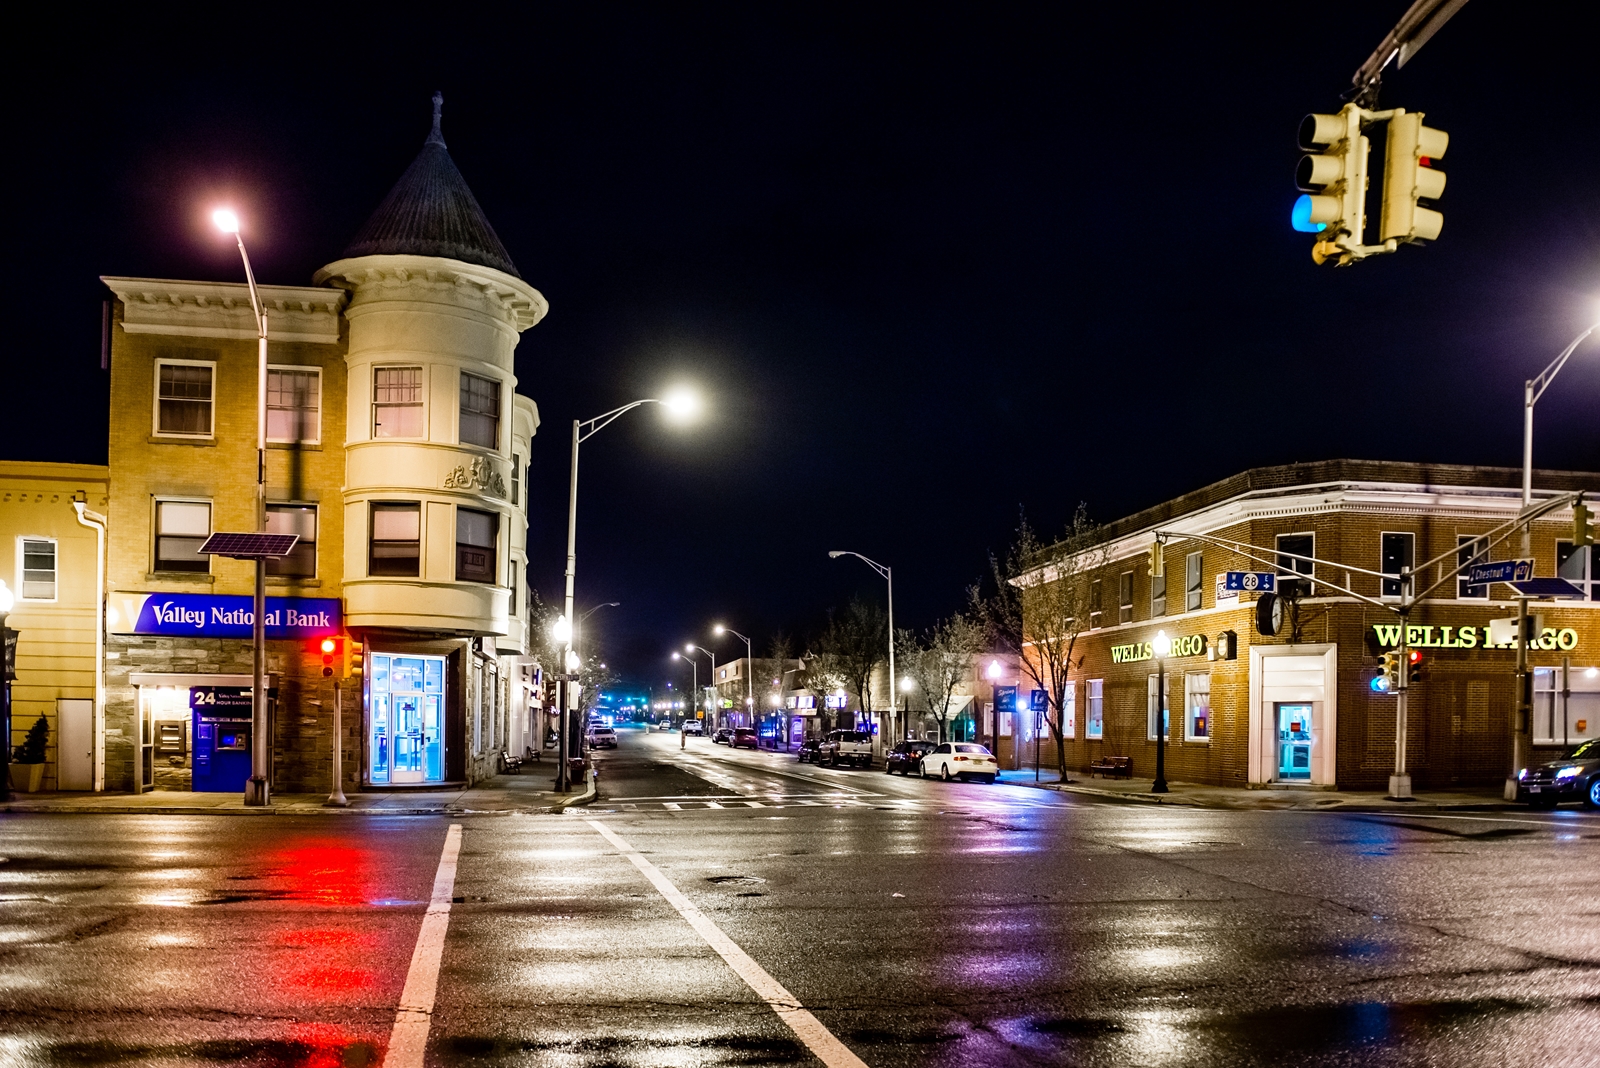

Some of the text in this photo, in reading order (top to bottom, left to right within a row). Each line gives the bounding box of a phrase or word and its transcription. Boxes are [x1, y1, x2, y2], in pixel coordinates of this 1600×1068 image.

[1244, 576, 1257, 587] 28
[1475, 567, 1504, 580] Chestnut
[152, 601, 330, 629] Valley Natioal Bank
[1373, 624, 1477, 648] WELLS
[1111, 641, 1153, 664] WELLS
[194, 691, 216, 705] 24
